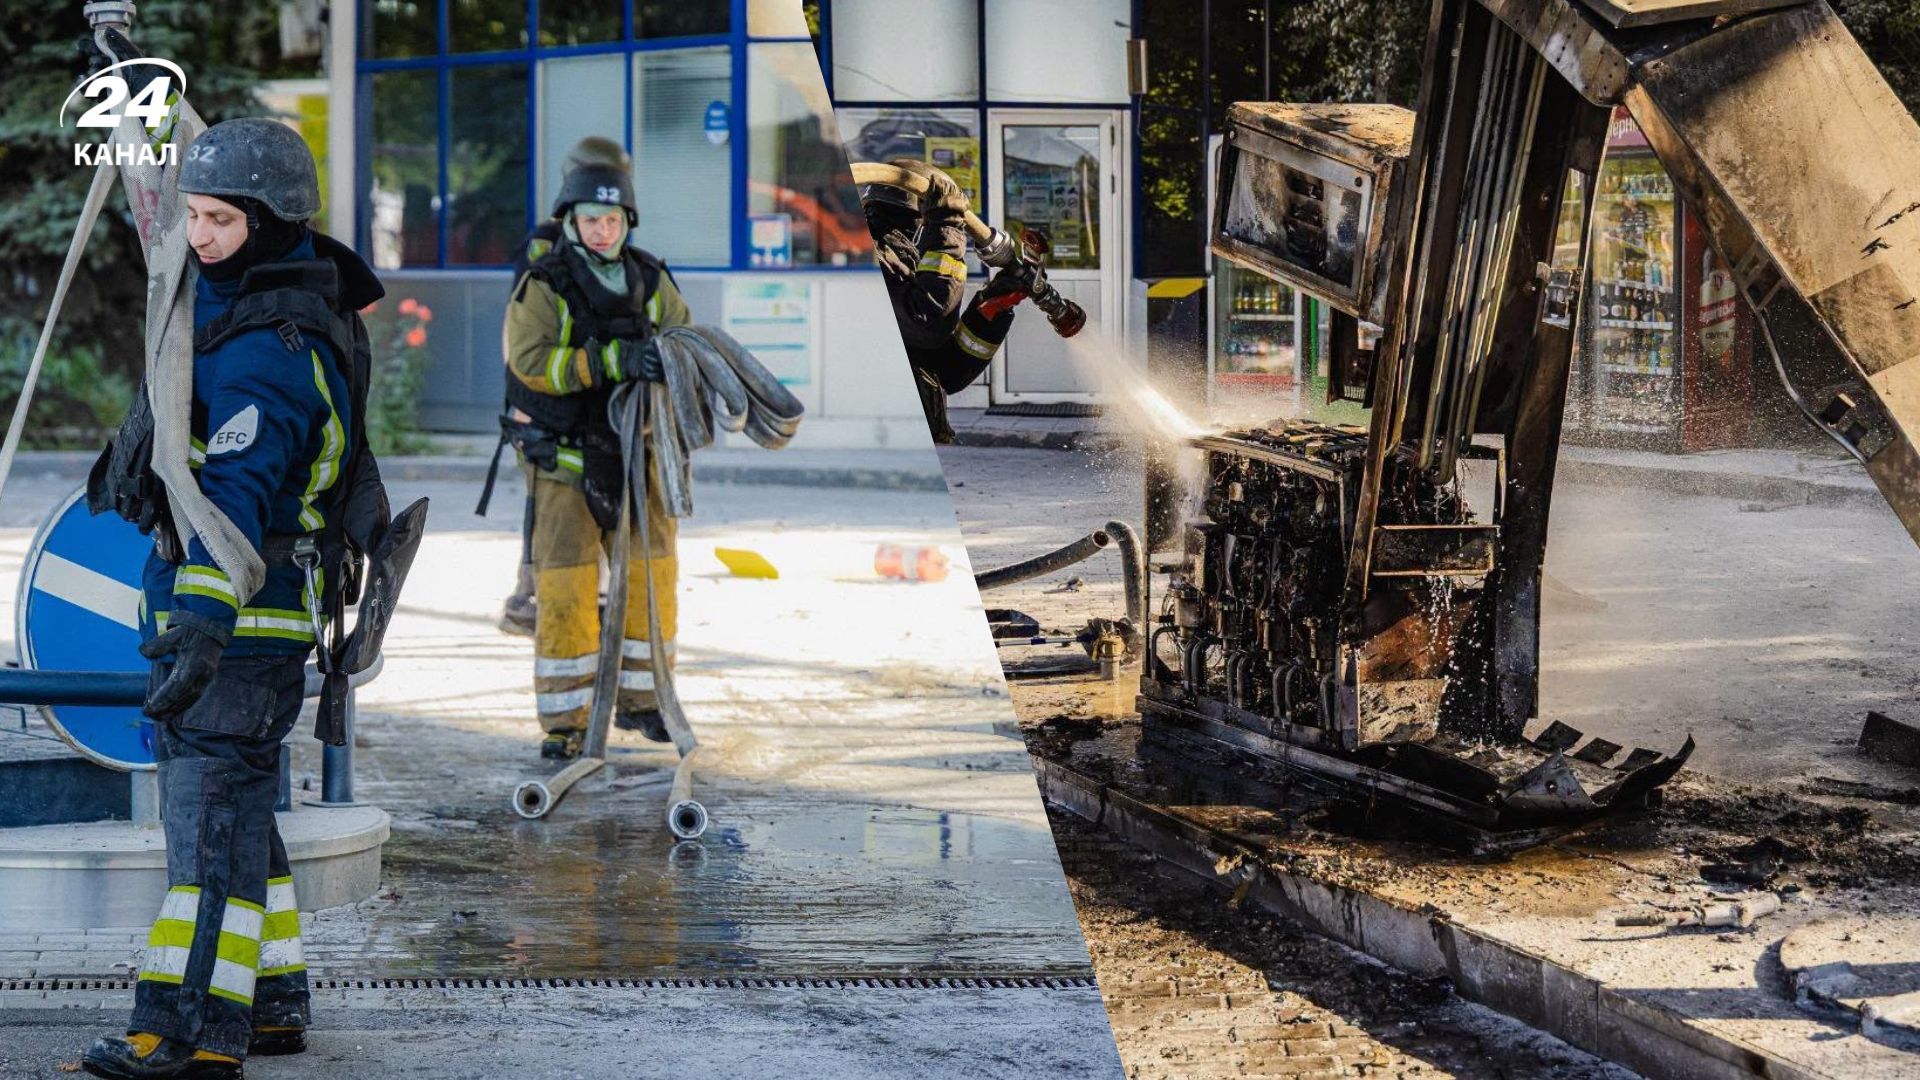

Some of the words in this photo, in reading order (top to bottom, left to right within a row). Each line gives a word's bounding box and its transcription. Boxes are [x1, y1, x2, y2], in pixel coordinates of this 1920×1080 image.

[188, 144, 216, 163] 32
[596, 185, 620, 202] 32
[216, 431, 248, 445] EFC
